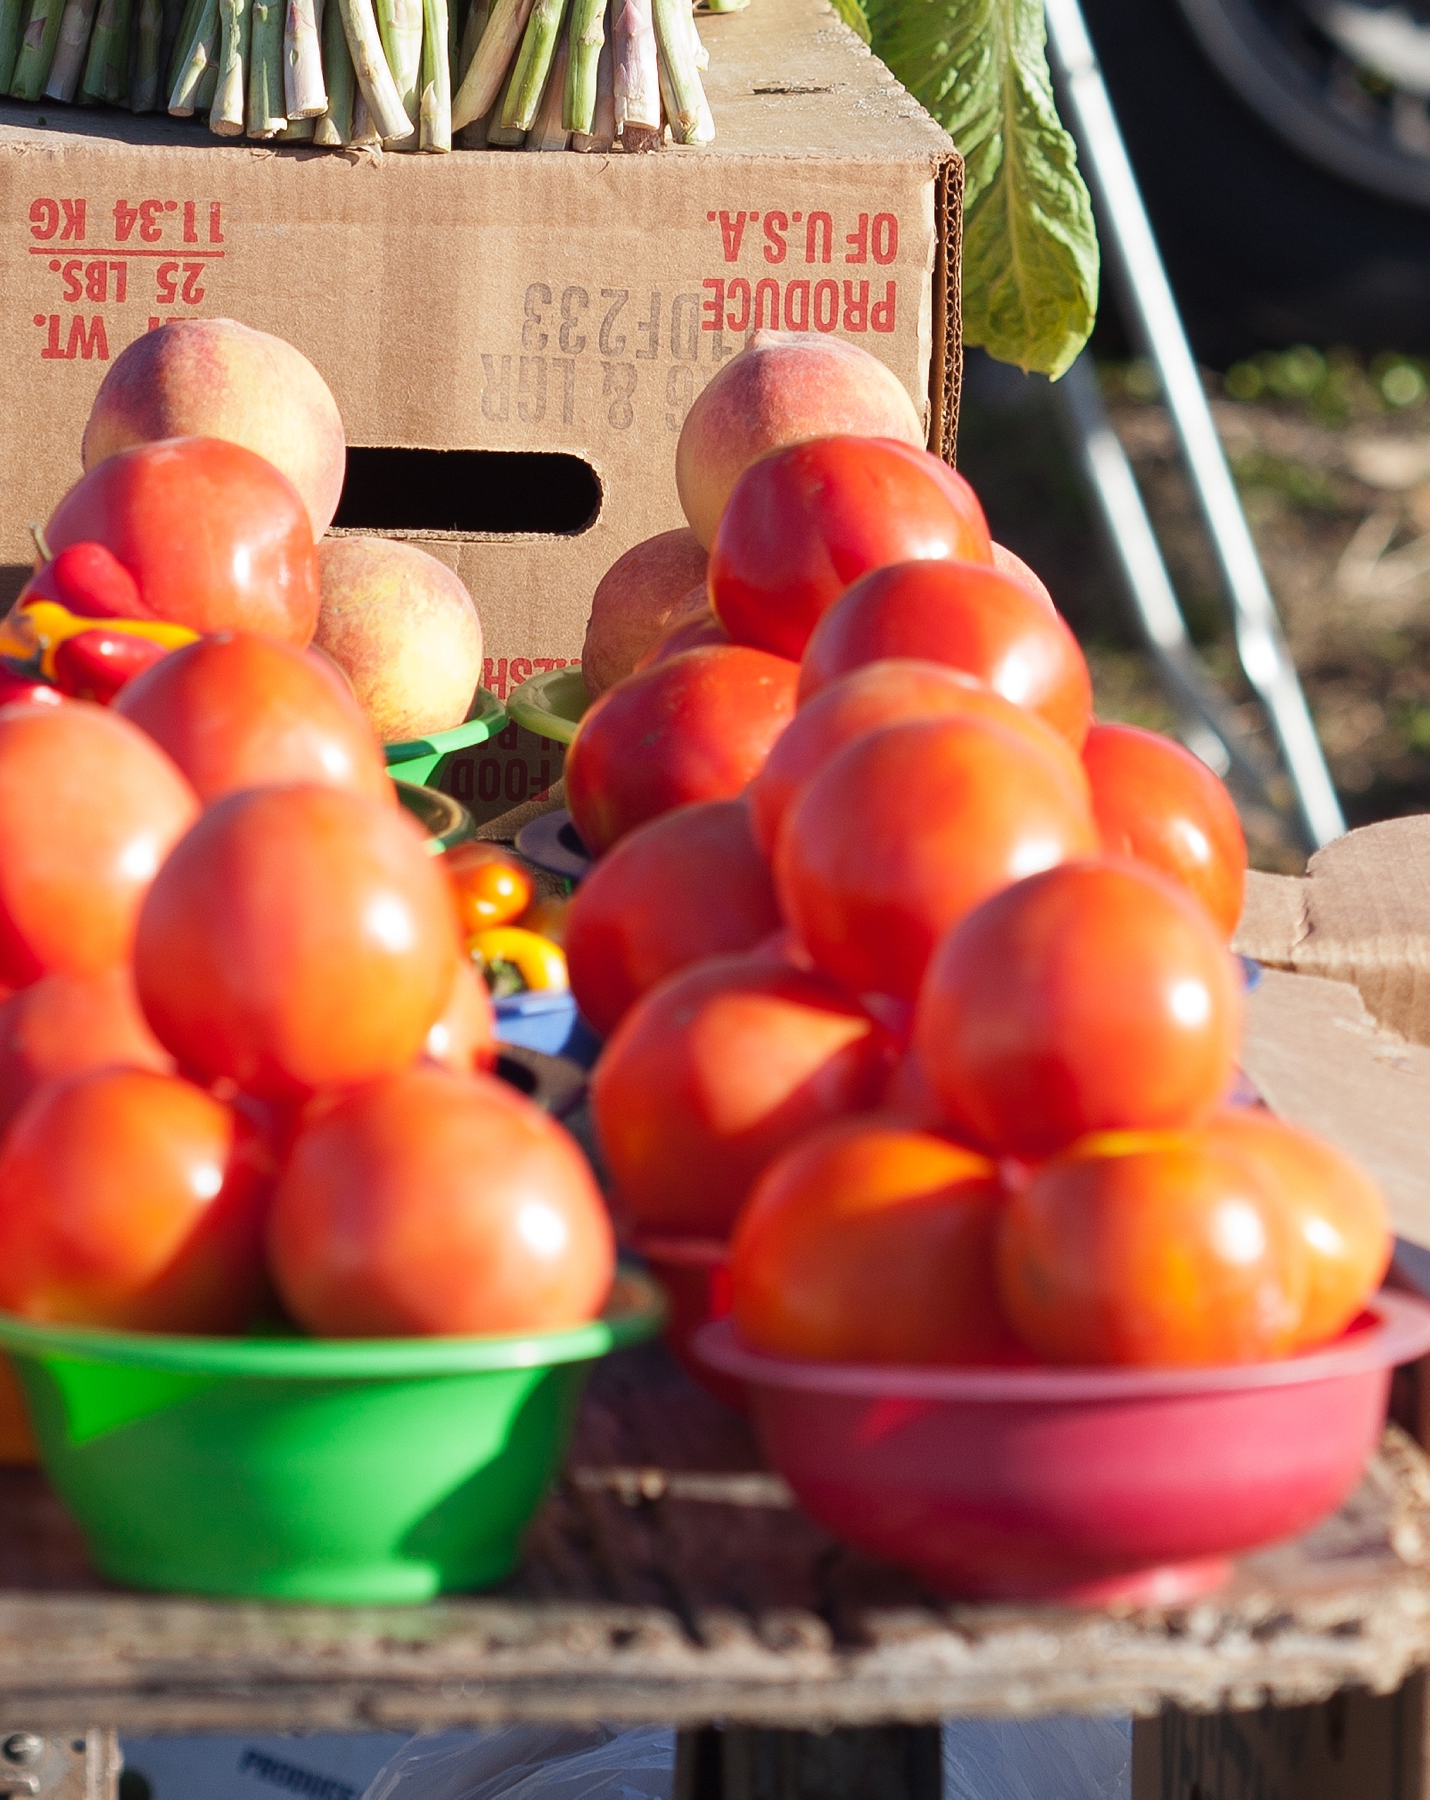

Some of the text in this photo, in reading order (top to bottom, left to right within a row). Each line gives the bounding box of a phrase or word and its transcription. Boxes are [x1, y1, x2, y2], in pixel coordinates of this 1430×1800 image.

[29, 197, 225, 243] 11.34 KG
[706, 210, 898, 265] OF U.S.A.
[48, 258, 206, 306] 25 LBS.
[701, 277, 897, 332] PRODUCE
[33, 313, 110, 360] WT.
[480, 353, 576, 427] LGR
[599, 360, 638, 430] &
[450, 757, 551, 802] FOOD
